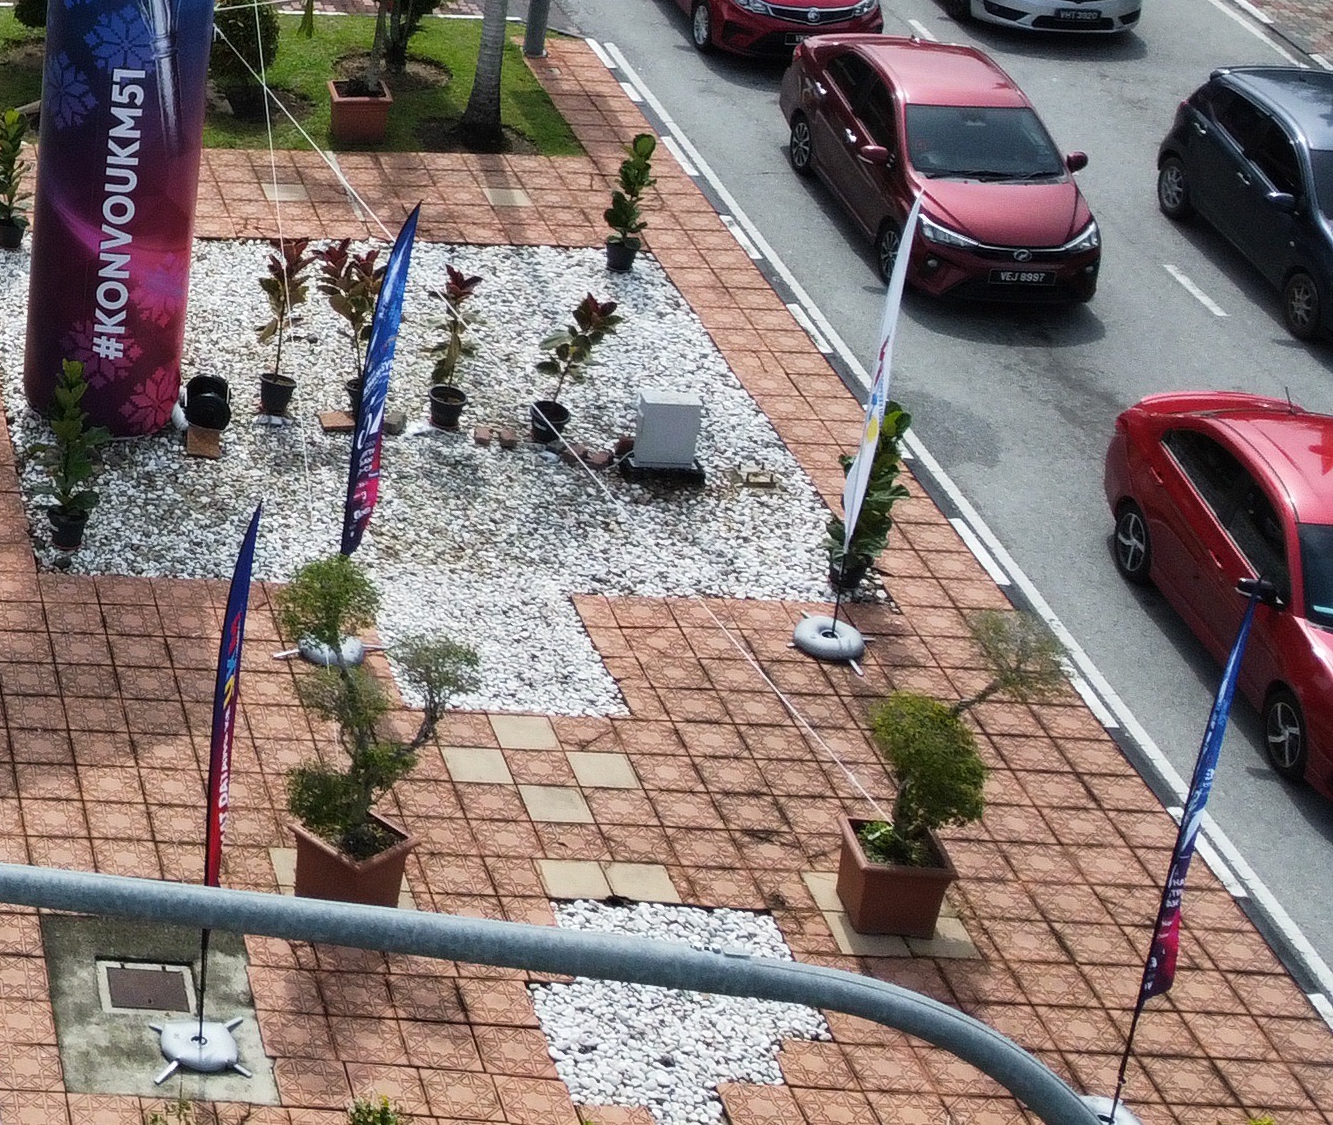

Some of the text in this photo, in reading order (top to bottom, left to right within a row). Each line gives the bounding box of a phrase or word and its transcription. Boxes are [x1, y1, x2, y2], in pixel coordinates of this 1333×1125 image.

[92, 67, 146, 360] #KONVOUKM51
[1000, 271, 1046, 282] VEJ 8997
